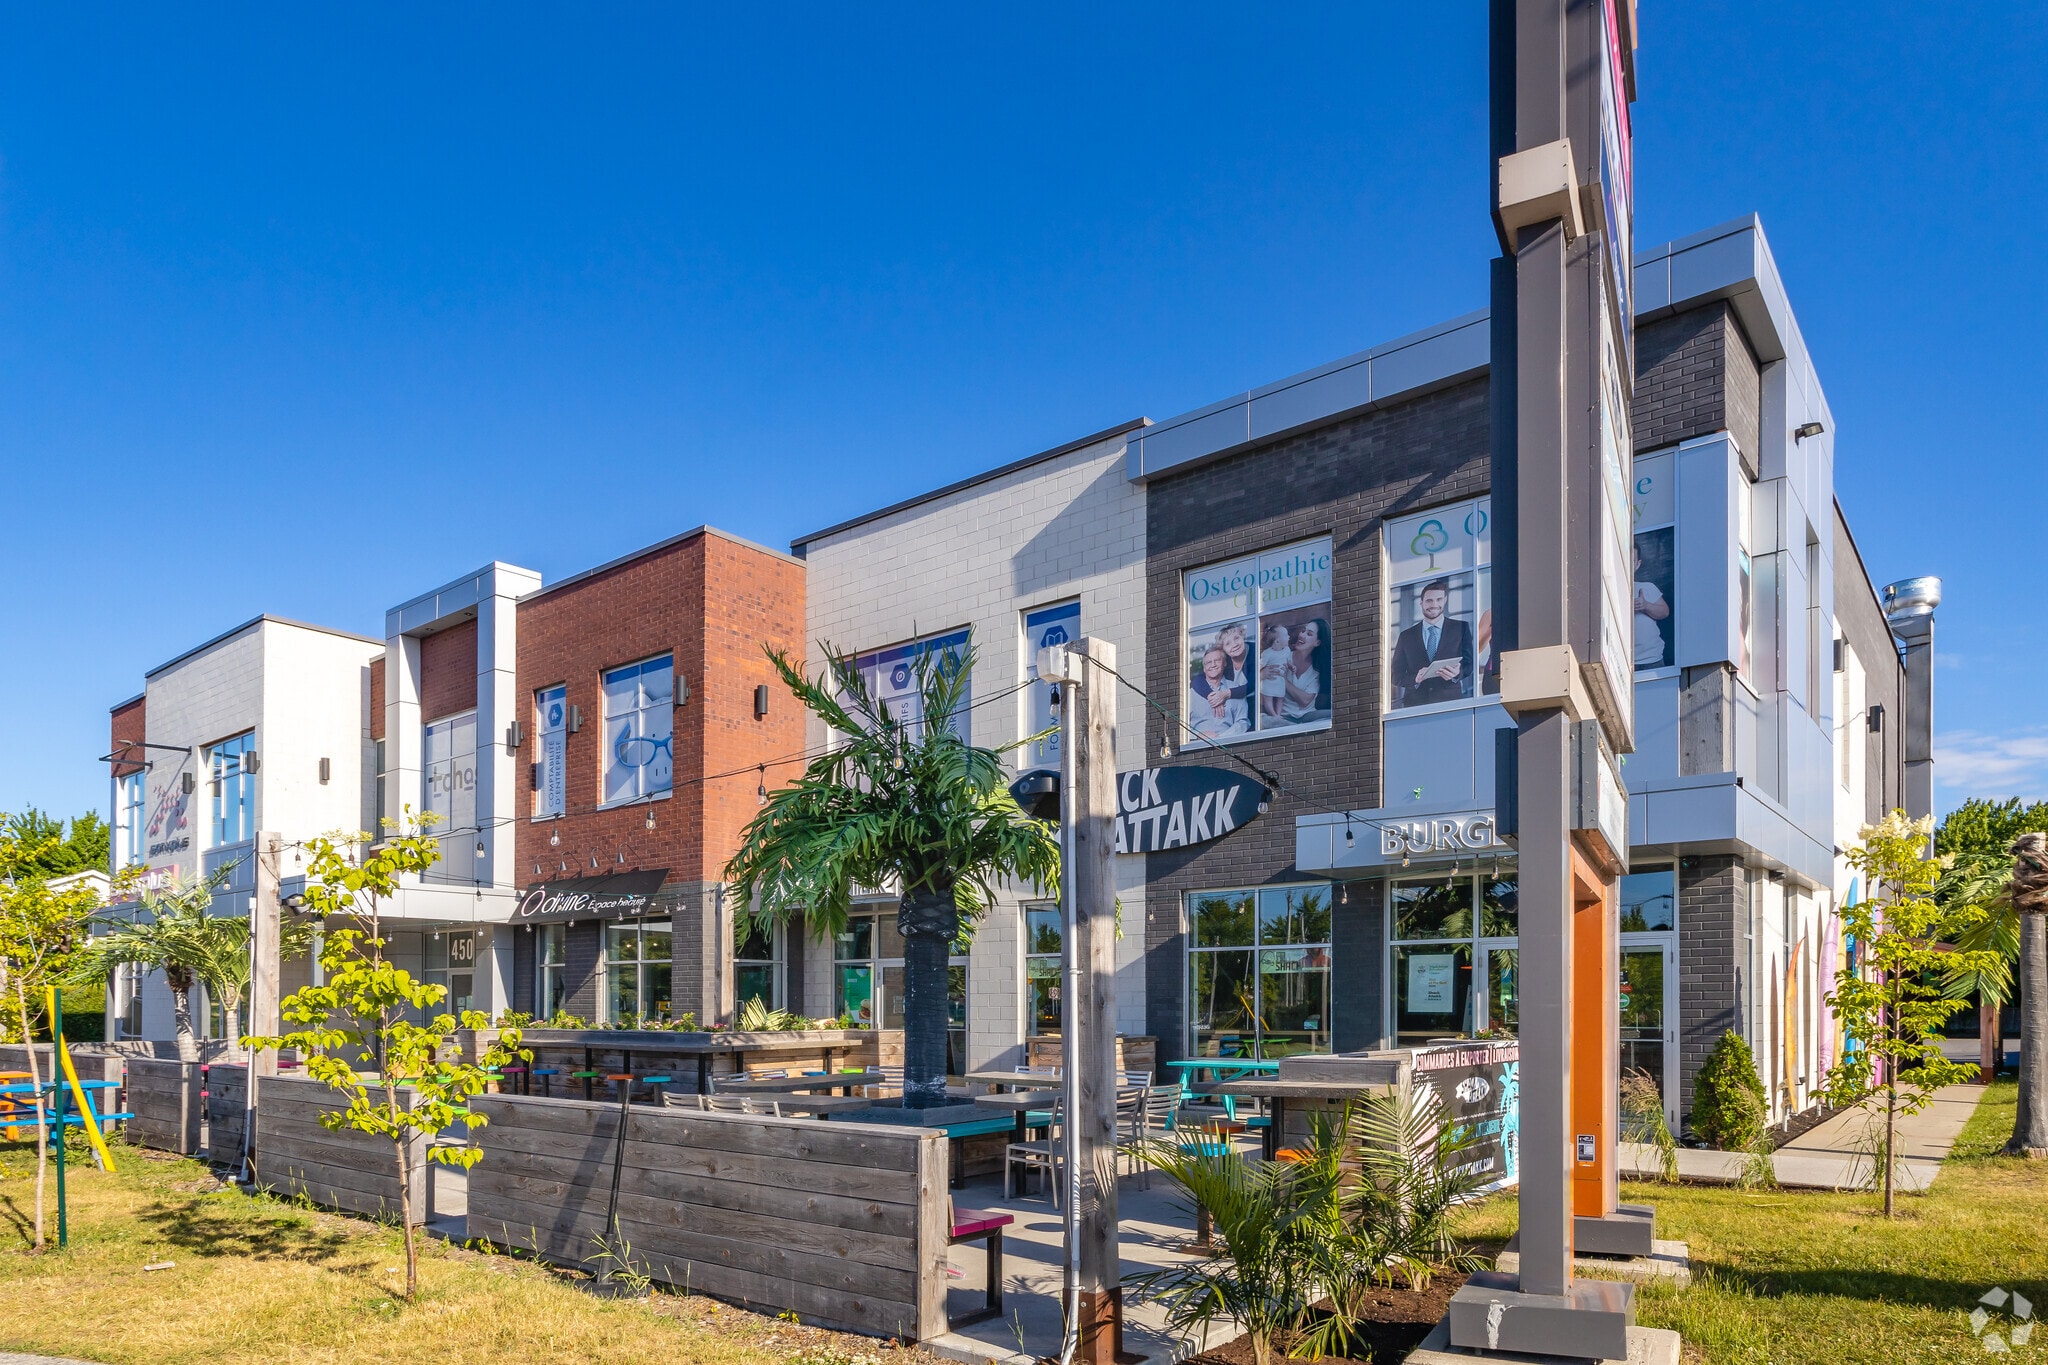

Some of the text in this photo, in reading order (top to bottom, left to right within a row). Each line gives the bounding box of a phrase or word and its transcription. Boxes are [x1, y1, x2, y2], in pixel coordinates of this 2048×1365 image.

[1190, 552, 1330, 601] Ostéopathie
[1115, 784, 1241, 854] ATTAKK
[451, 939, 473, 961] 450
